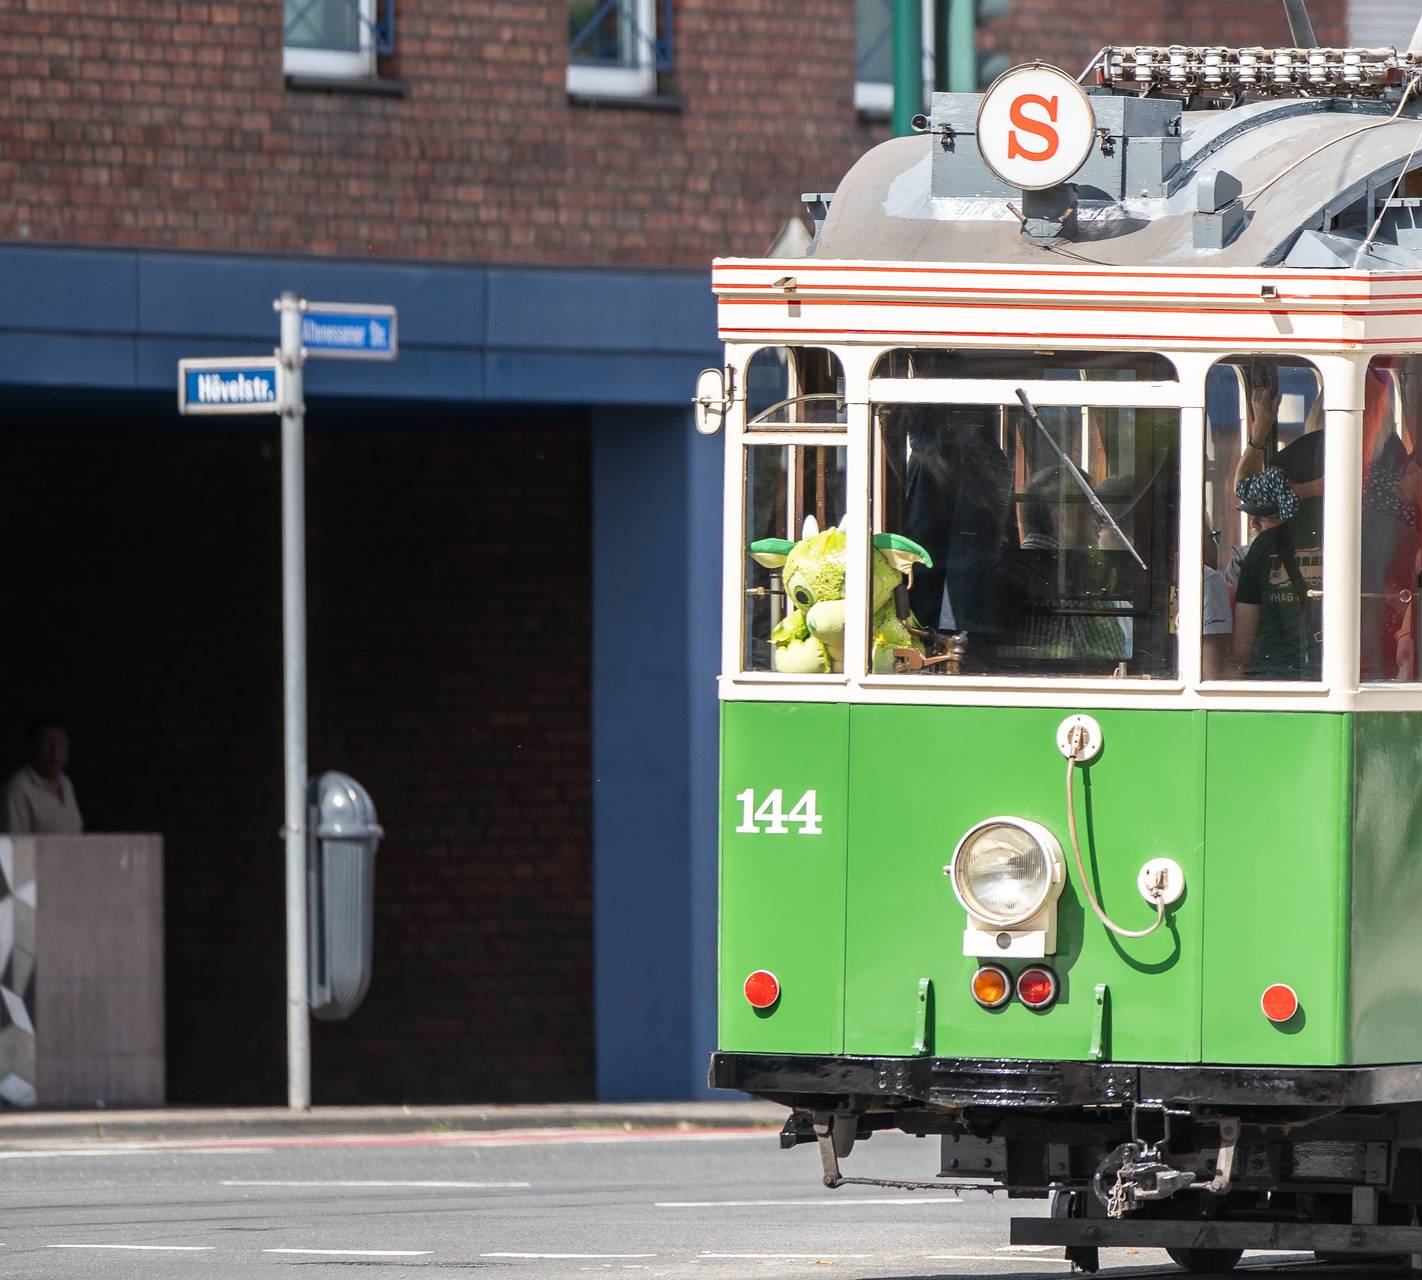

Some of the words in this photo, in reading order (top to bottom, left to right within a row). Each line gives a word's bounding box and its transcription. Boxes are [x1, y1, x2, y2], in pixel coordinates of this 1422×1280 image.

[1008, 93, 1059, 162] S
[198, 373, 275, 403] Hövelstr.
[736, 788, 823, 835] 144
